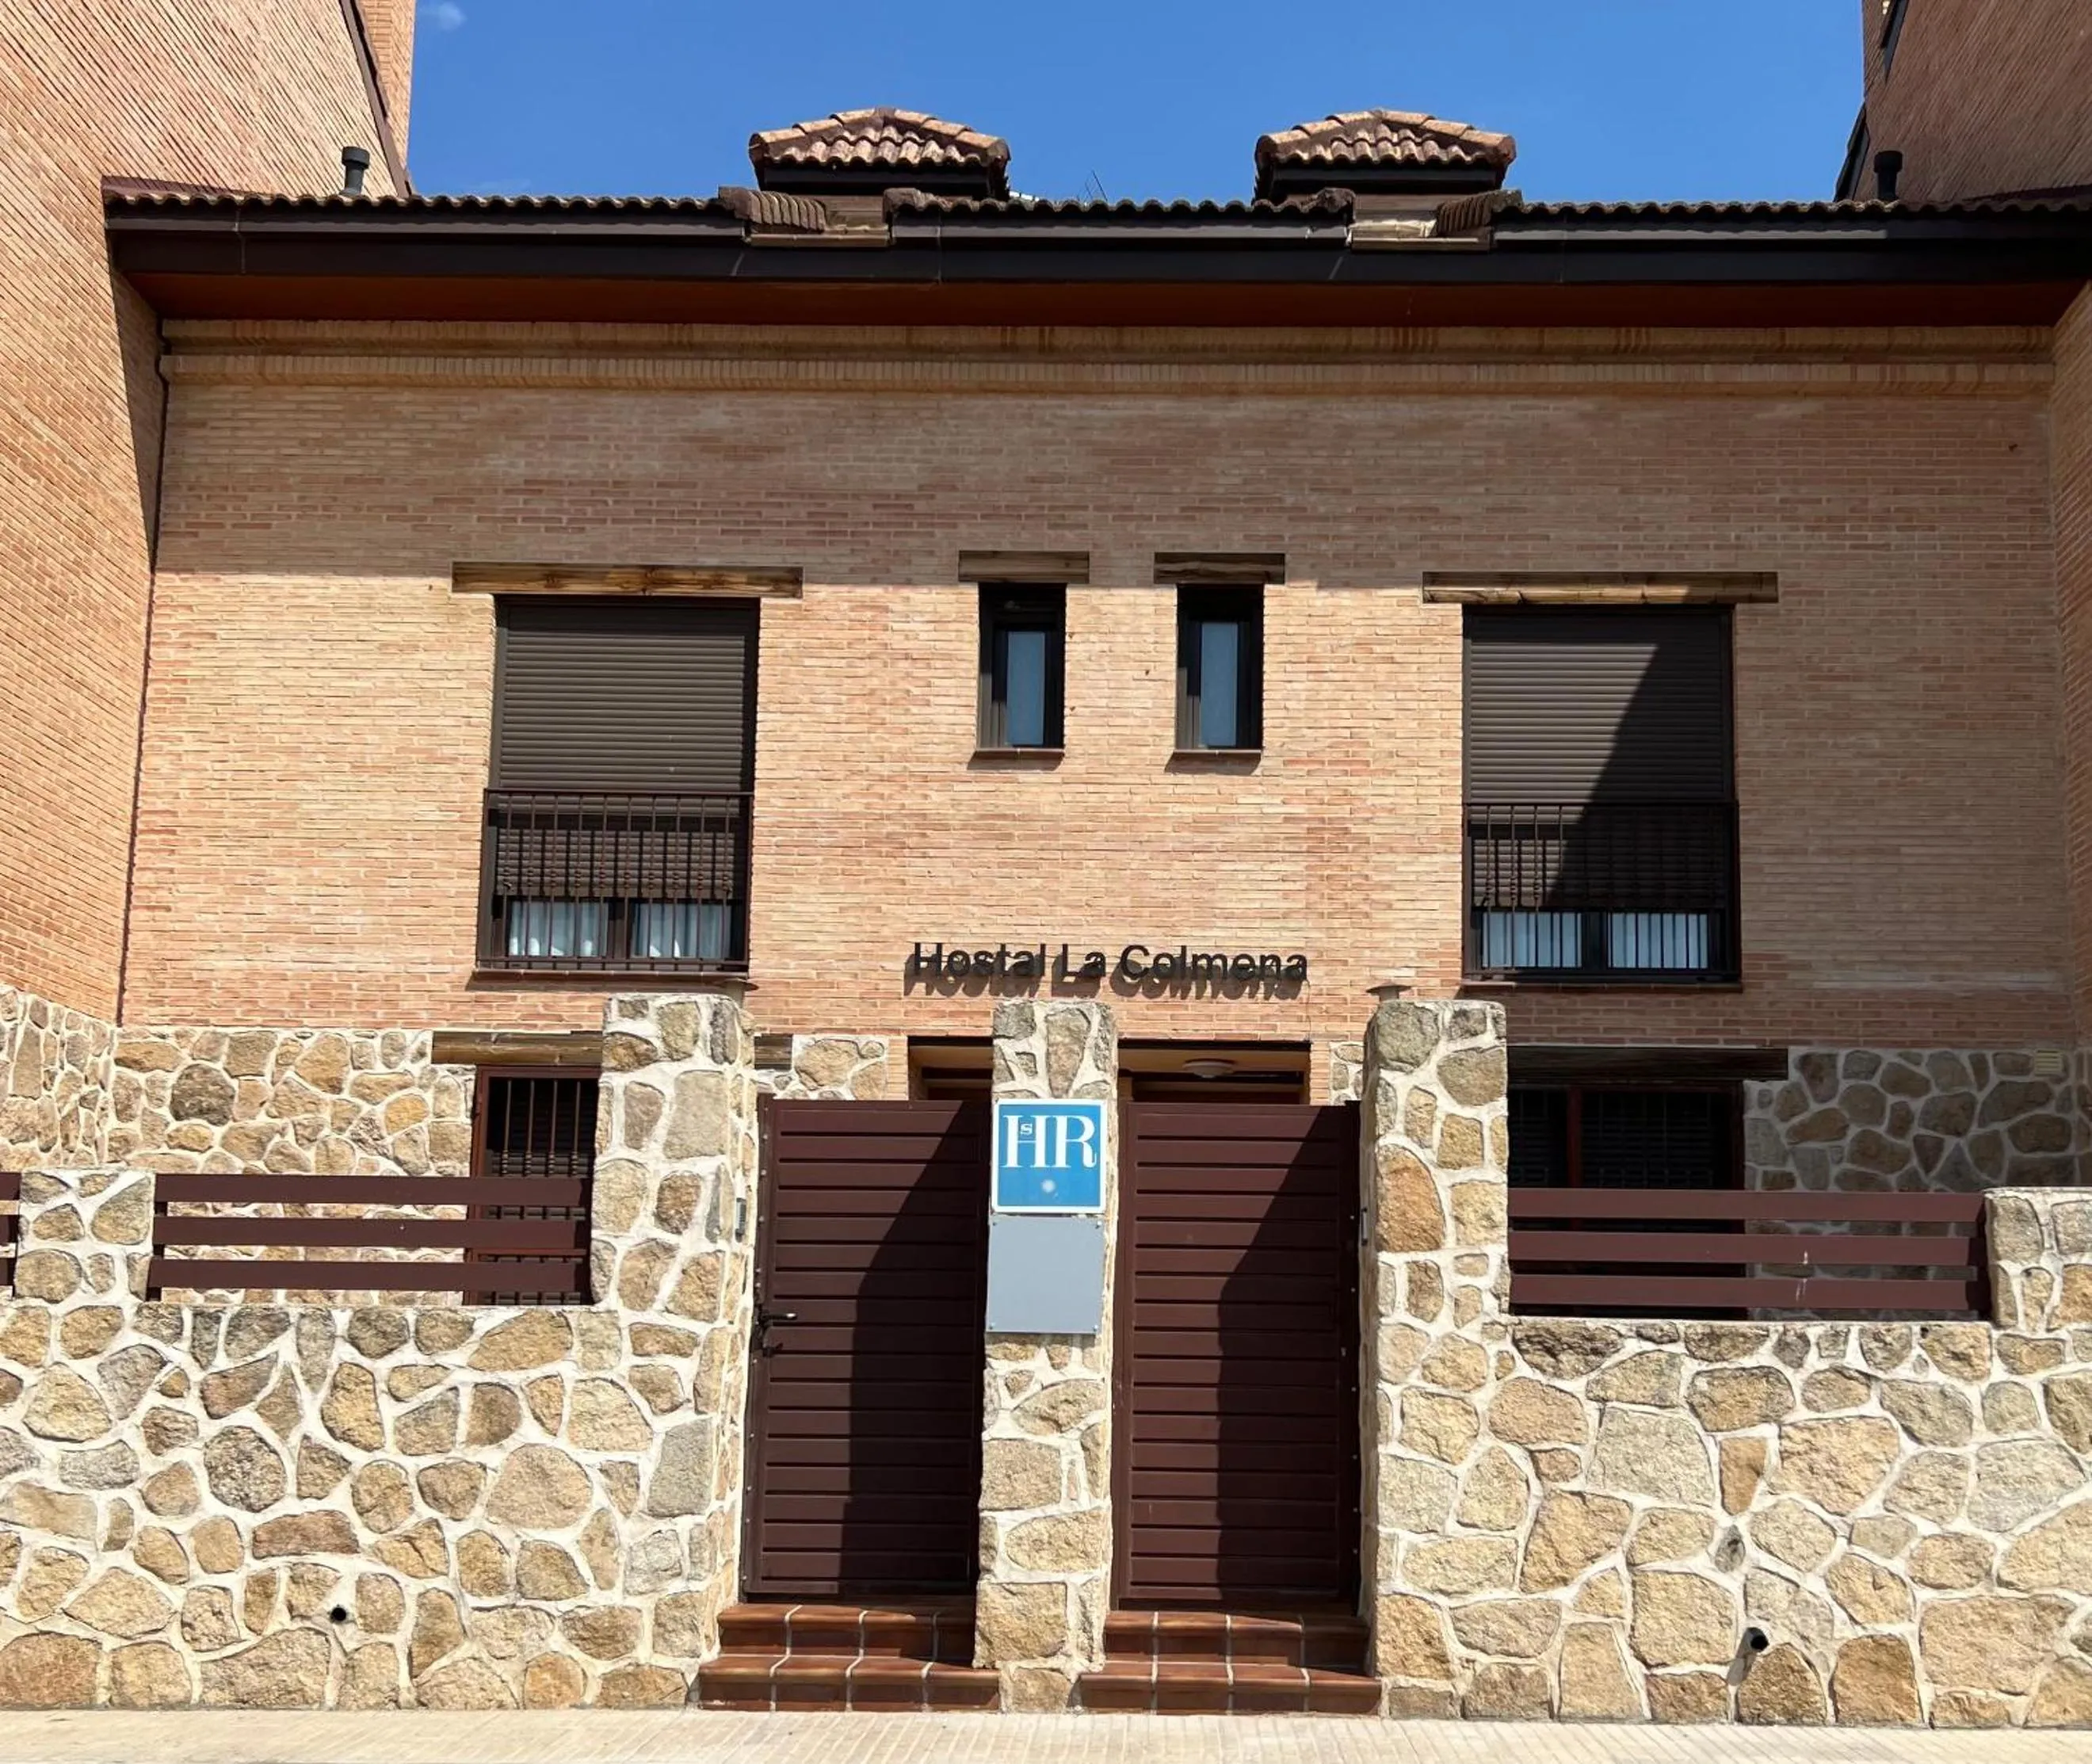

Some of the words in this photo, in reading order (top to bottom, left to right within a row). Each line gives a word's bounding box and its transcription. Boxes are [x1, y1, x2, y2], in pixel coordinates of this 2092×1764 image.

[914, 942, 1046, 978] Hostal
[1062, 943, 1107, 977] La
[1121, 945, 1308, 981] Colmena
